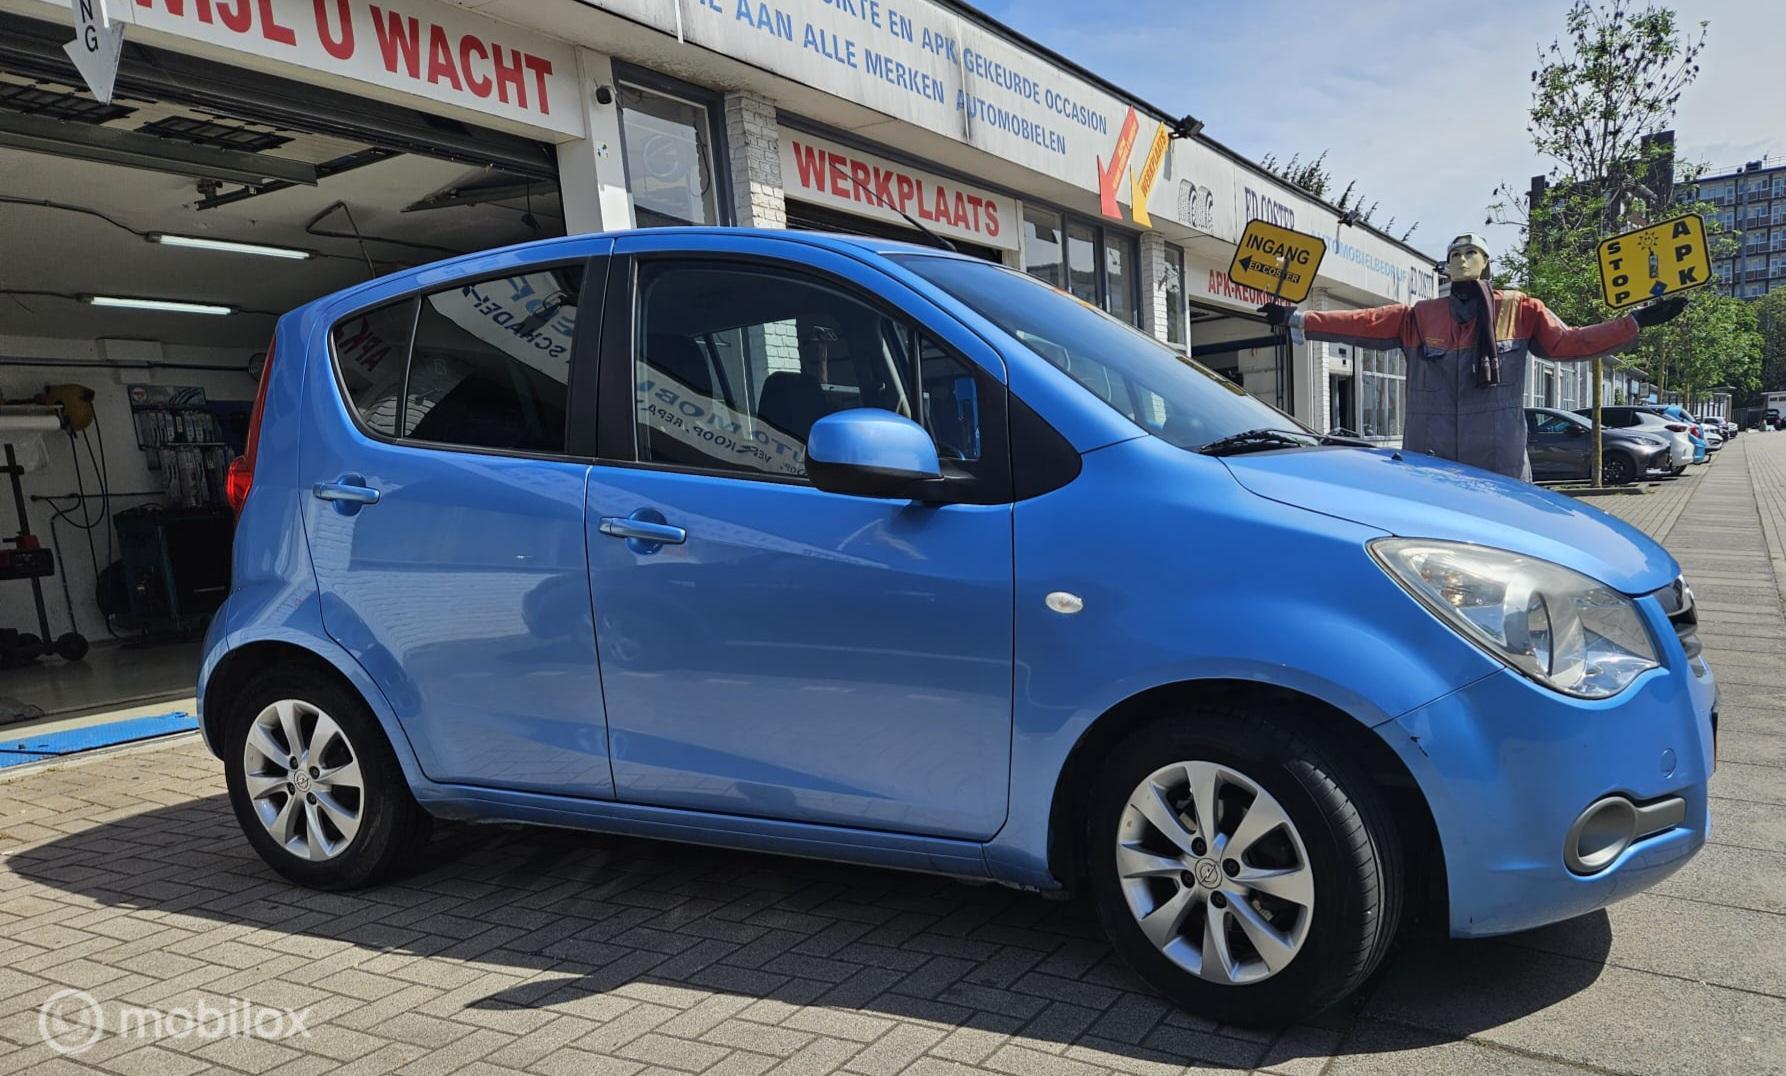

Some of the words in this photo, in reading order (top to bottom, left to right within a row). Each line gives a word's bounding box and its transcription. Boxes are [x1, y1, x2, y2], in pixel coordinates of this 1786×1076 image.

[313, 0, 355, 60] U
[369, 4, 553, 115] WACHT
[735, 0, 794, 42] AAN
[802, 22, 858, 69] ALLE
[865, 47, 945, 104] MERKEN
[956, 88, 1067, 155] AUTOMOBIELEN
[888, 9, 914, 42] EN
[922, 27, 959, 65] APK
[963, 47, 1041, 105] GEKEURDE
[1045, 89, 1108, 136] OCCASION
[792, 140, 1000, 238] WERKPLAATS
[1245, 233, 1311, 266] INGANG
[1249, 260, 1262, 271] ED
[1262, 264, 1300, 284] COSER
[1607, 241, 1631, 305] STOP
[1672, 220, 1699, 286] APK
